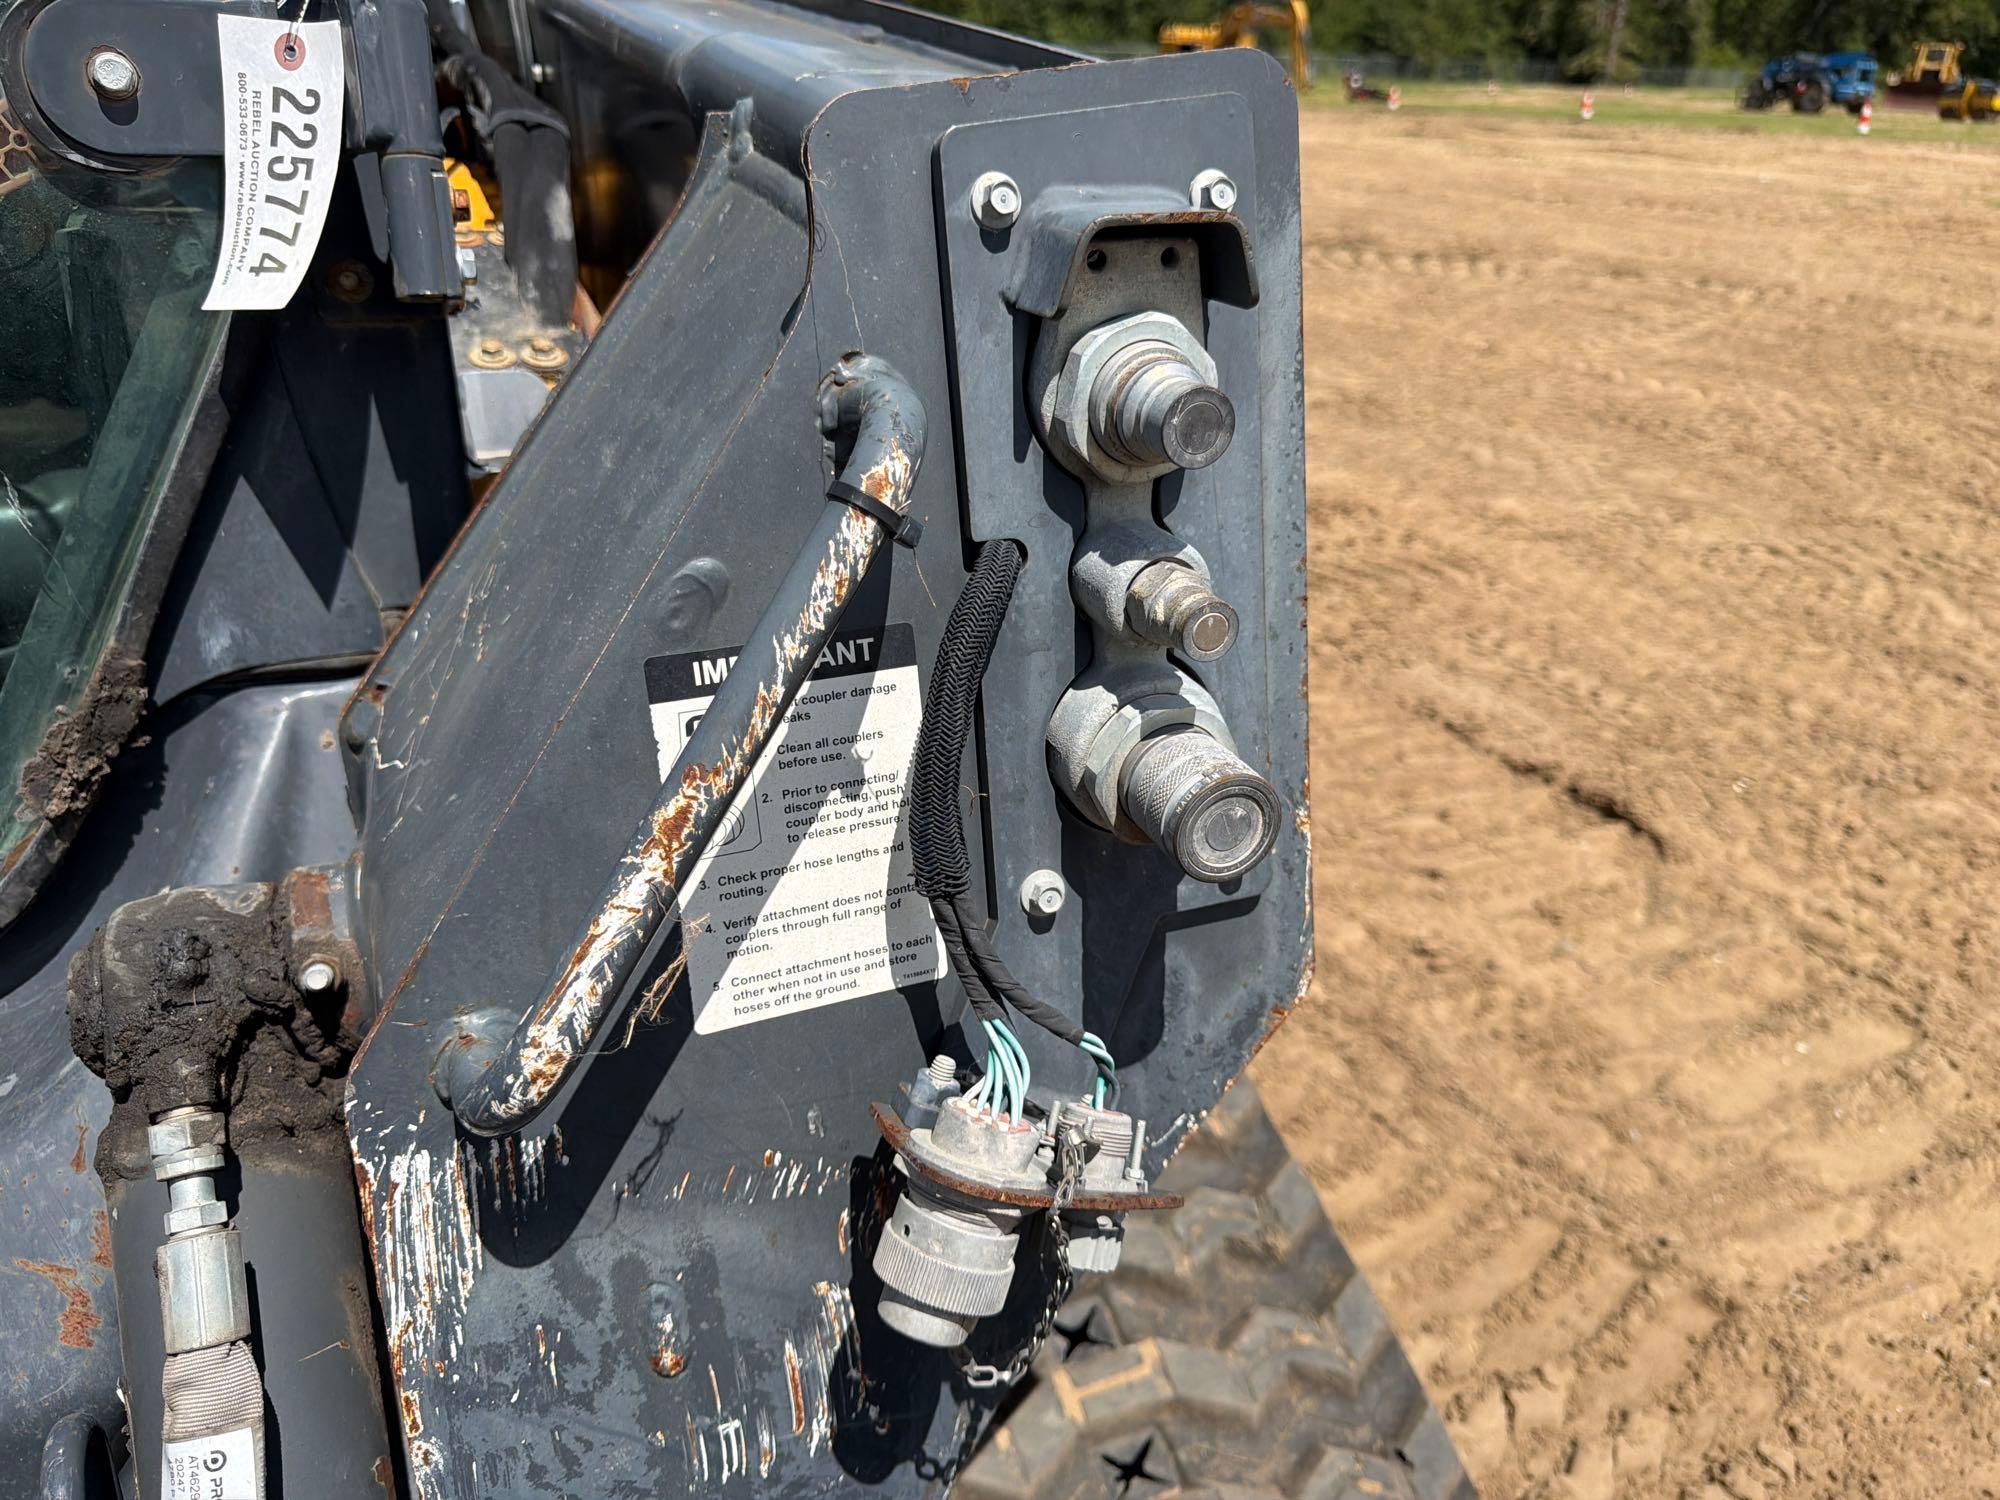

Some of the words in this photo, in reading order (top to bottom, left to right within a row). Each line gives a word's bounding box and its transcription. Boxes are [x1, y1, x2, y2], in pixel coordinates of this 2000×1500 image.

[237, 71, 248, 151] 800-533-0673
[252, 90, 262, 137] REBEL
[249, 86, 321, 277] 225774
[250, 141, 261, 203] AUCTION
[221, 161, 247, 286] www.rebelauction.com
[235, 208, 256, 272] COMPANY
[801, 690, 847, 705] coupler
[850, 683, 897, 698] damage
[783, 711, 811, 724] eaks
[777, 741, 811, 755] Clean
[815, 738, 829, 750] all
[832, 730, 884, 746] couplers
[778, 755, 818, 770] before
[821, 752, 846, 763] use.
[761, 793, 772, 804] 2.
[782, 787, 812, 800] Prior
[815, 785, 827, 794] to
[830, 770, 899, 791] connecting/
[784, 791, 872, 814] disconnecting,
[875, 785, 904, 800] push
[785, 813, 831, 829] coupler
[834, 806, 864, 820] body
[867, 801, 889, 814] and
[892, 797, 911, 809] hol
[787, 833, 800, 843] to
[803, 825, 846, 841] release
[849, 814, 904, 833] pressure.
[699, 880, 710, 891] 3.
[718, 870, 757, 887] Check
[760, 862, 800, 881] proper
[804, 857, 833, 870] hose
[836, 848, 880, 864] lengths
[883, 841, 904, 855] and
[719, 885, 768, 902] routing.
[705, 923, 716, 935] 4.
[723, 912, 758, 930] Verify
[762, 900, 830, 923] attachment
[832, 894, 861, 908] does
[864, 890, 883, 903] not
[725, 926, 779, 945] couplers
[782, 914, 830, 934] through
[832, 910, 851, 922] full
[854, 904, 887, 918] range
[889, 898, 901, 909] of
[713, 981, 724, 991] 5.
[731, 969, 782, 988] Connect
[785, 953, 851, 975] attachment
[854, 945, 889, 959] hoses
[891, 942, 903, 951] to
[906, 934, 933, 948] each
[726, 943, 773, 960] motion.
[733, 986, 764, 1002] other
[768, 979, 800, 993] when
[803, 974, 822, 986] not
[826, 970, 837, 980] in
[840, 965, 862, 976] use
[864, 958, 886, 972] and
[889, 952, 918, 966] store
[733, 999, 771, 1016] hoses
[774, 994, 790, 1008] off
[793, 991, 813, 1002] the
[815, 979, 861, 998] ground.
[174, 1457, 186, 1492] 20247
[210, 1477, 223, 1500] PR
